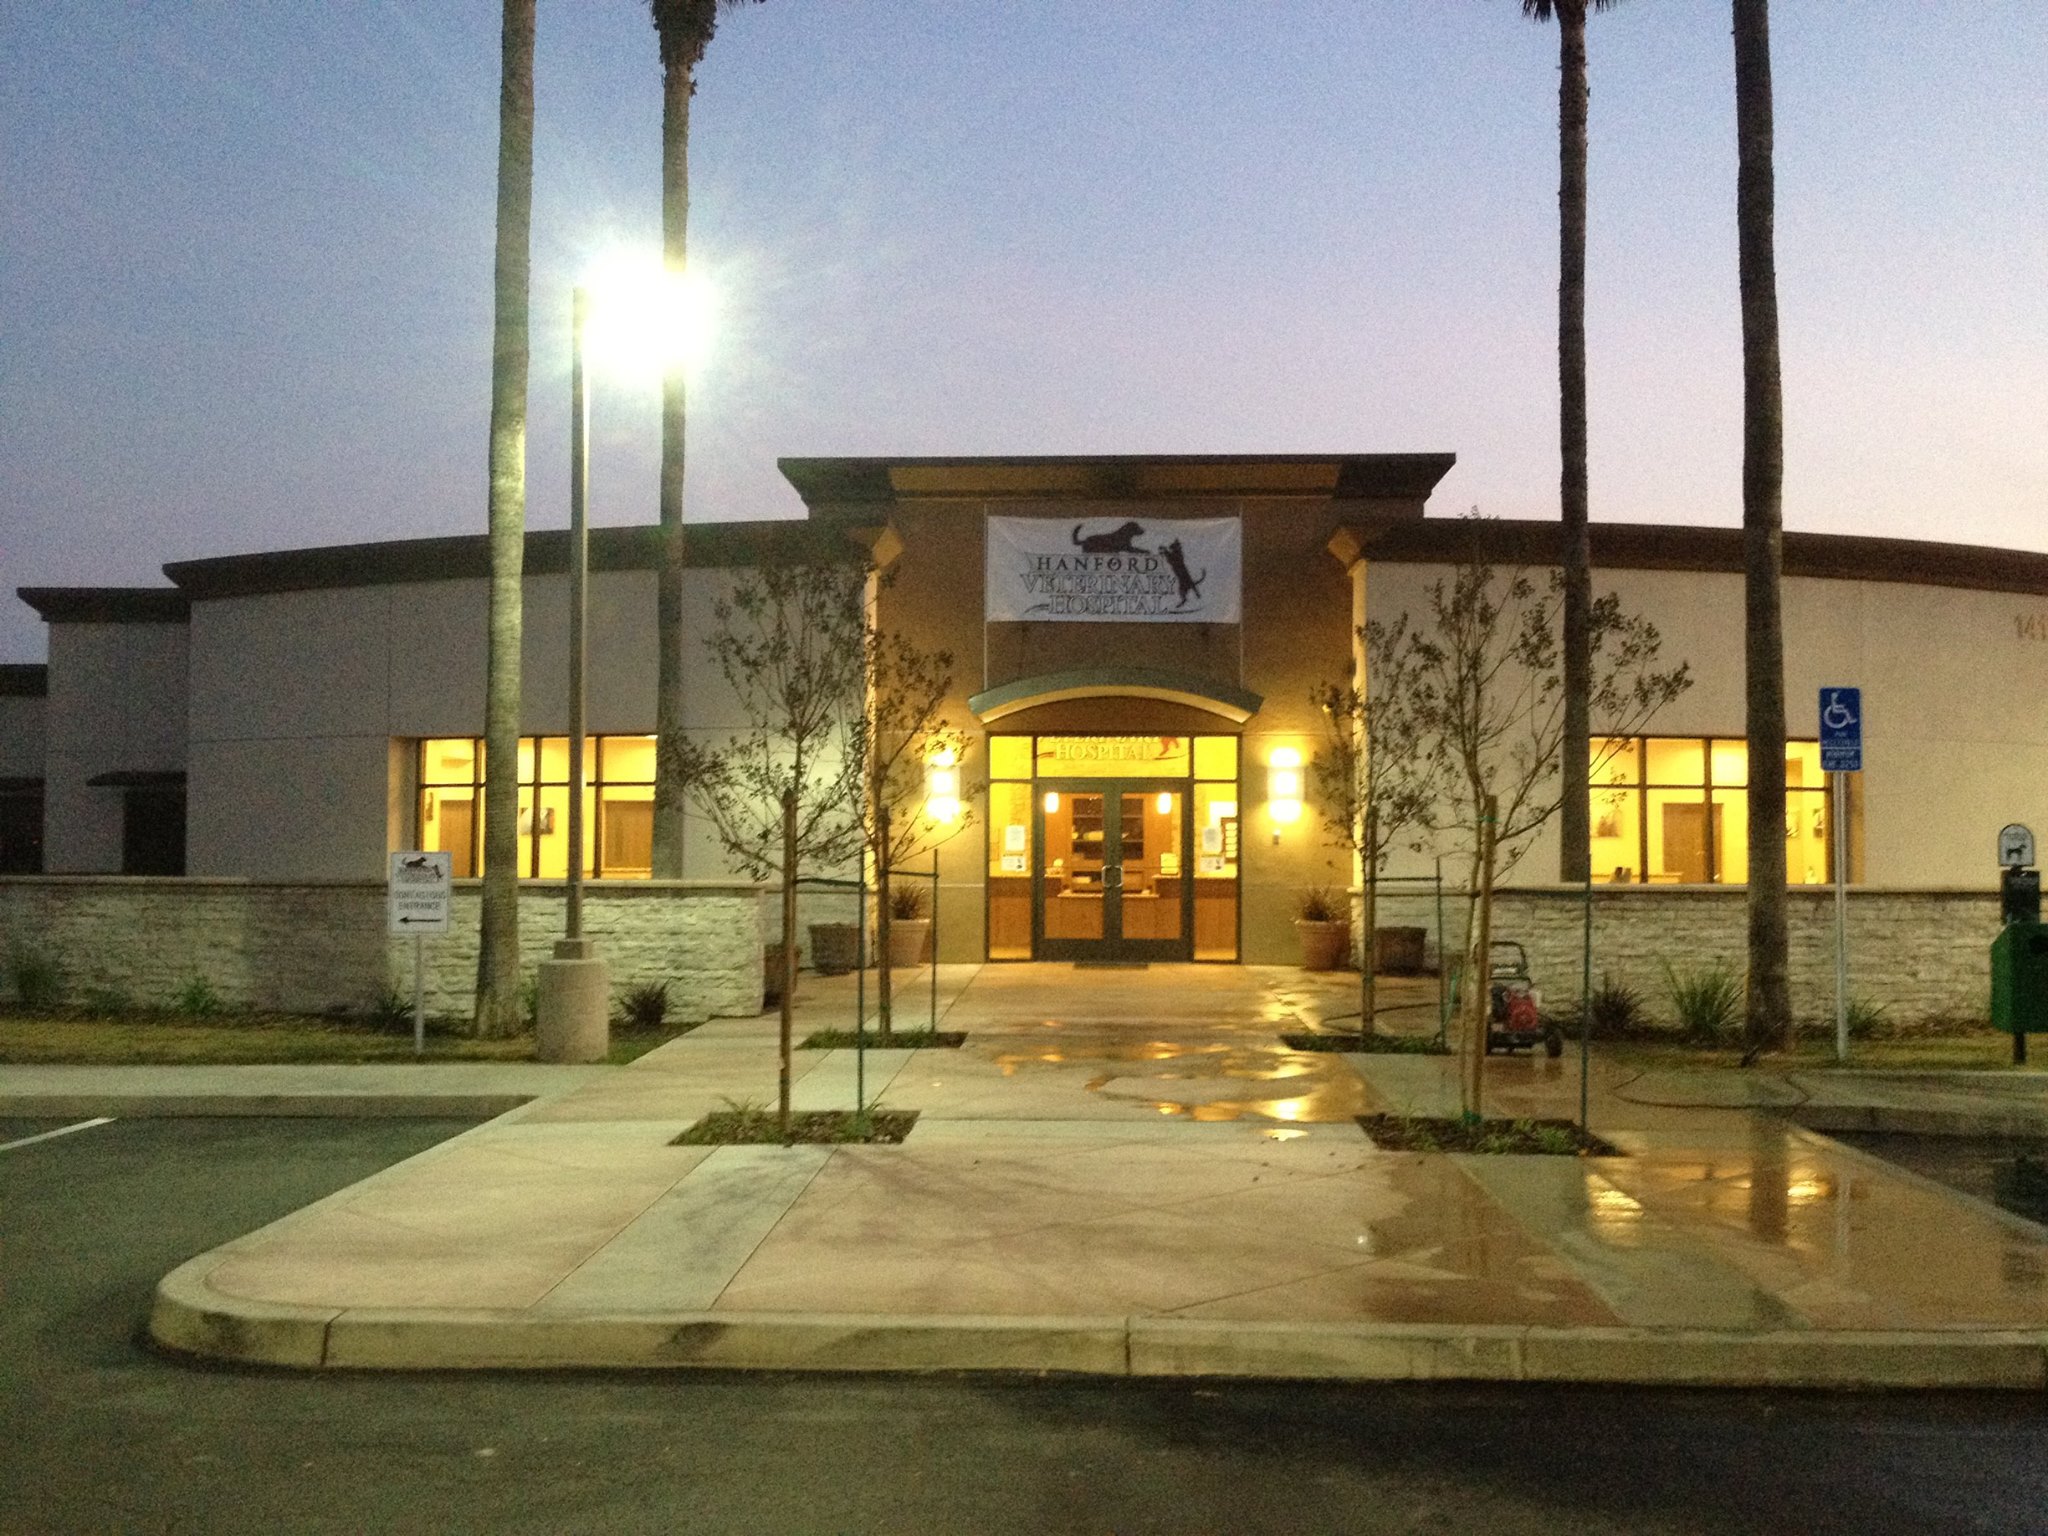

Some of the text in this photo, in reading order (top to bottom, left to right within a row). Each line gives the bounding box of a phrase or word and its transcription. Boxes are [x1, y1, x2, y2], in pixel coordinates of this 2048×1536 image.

[1037, 556, 1159, 572] HANFORD
[1020, 574, 1178, 595] VETERINARY
[1048, 594, 1169, 615] HOSPITAL
[1055, 742, 1153, 761] HOSPITAL
